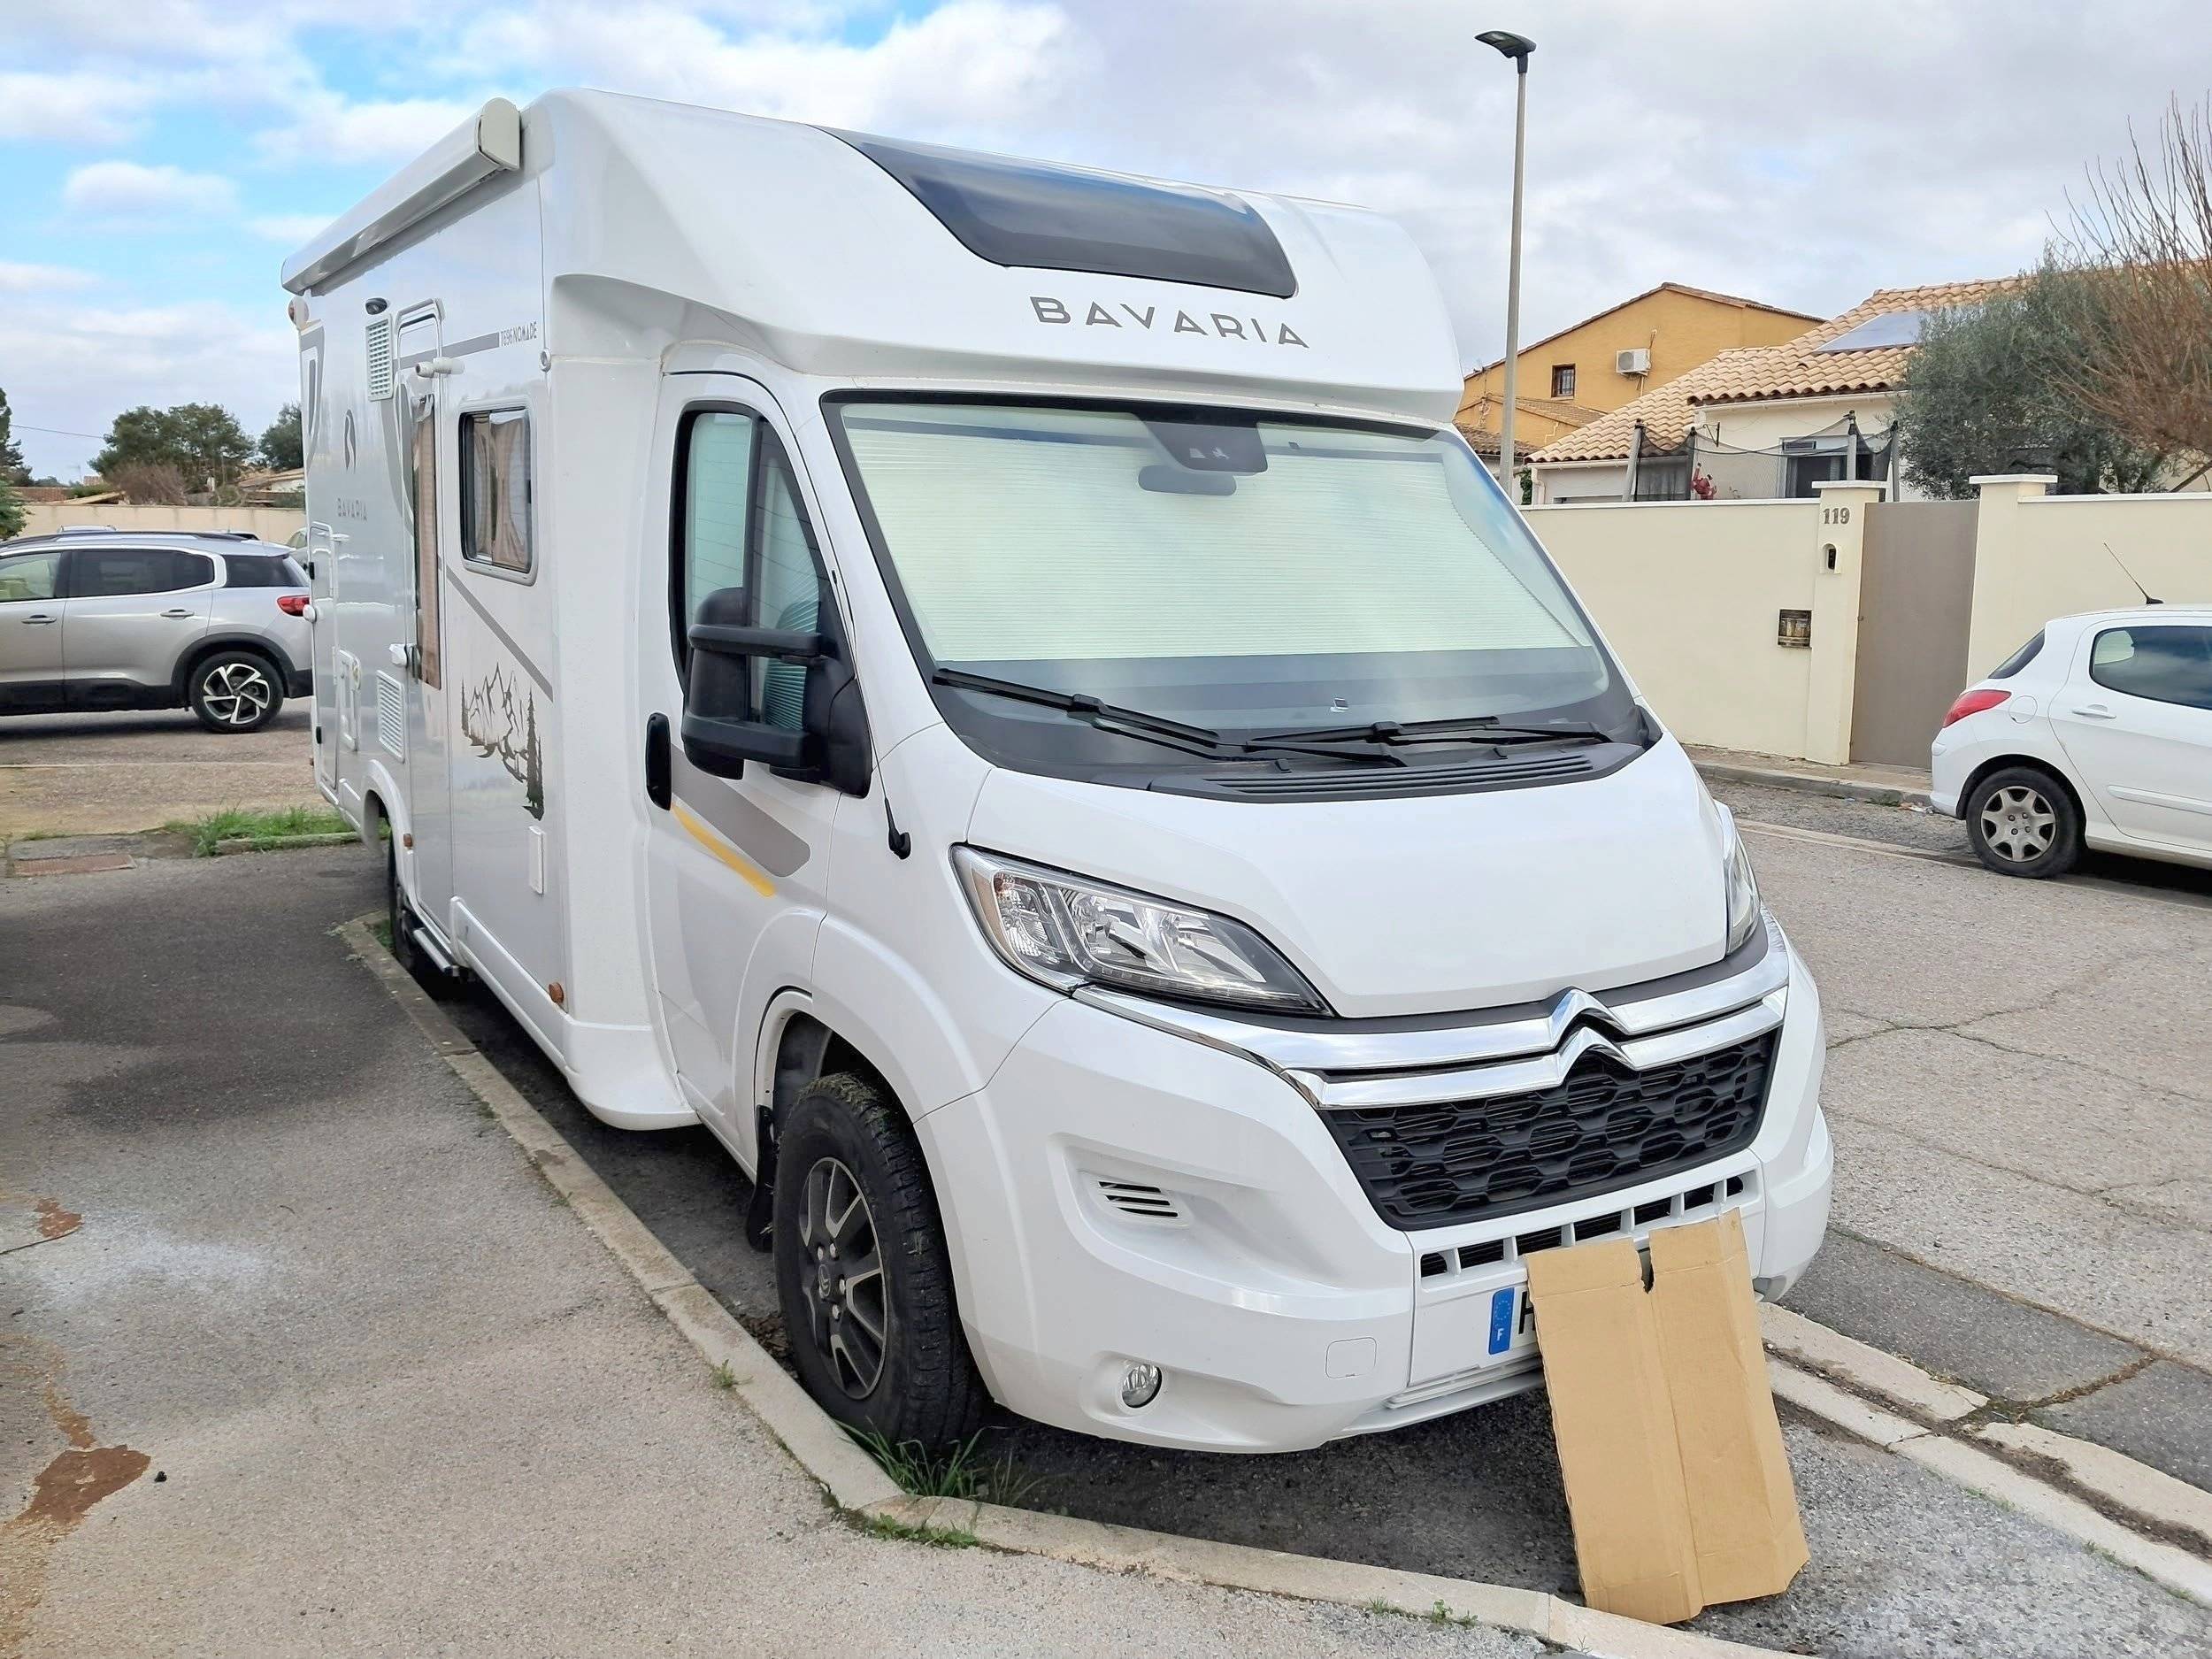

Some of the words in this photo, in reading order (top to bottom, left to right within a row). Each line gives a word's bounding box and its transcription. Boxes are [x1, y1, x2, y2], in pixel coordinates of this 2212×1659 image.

[1030, 296, 1310, 349] BAVARIA
[1823, 507, 1850, 525] 119
[1496, 1328, 1504, 1341] F
